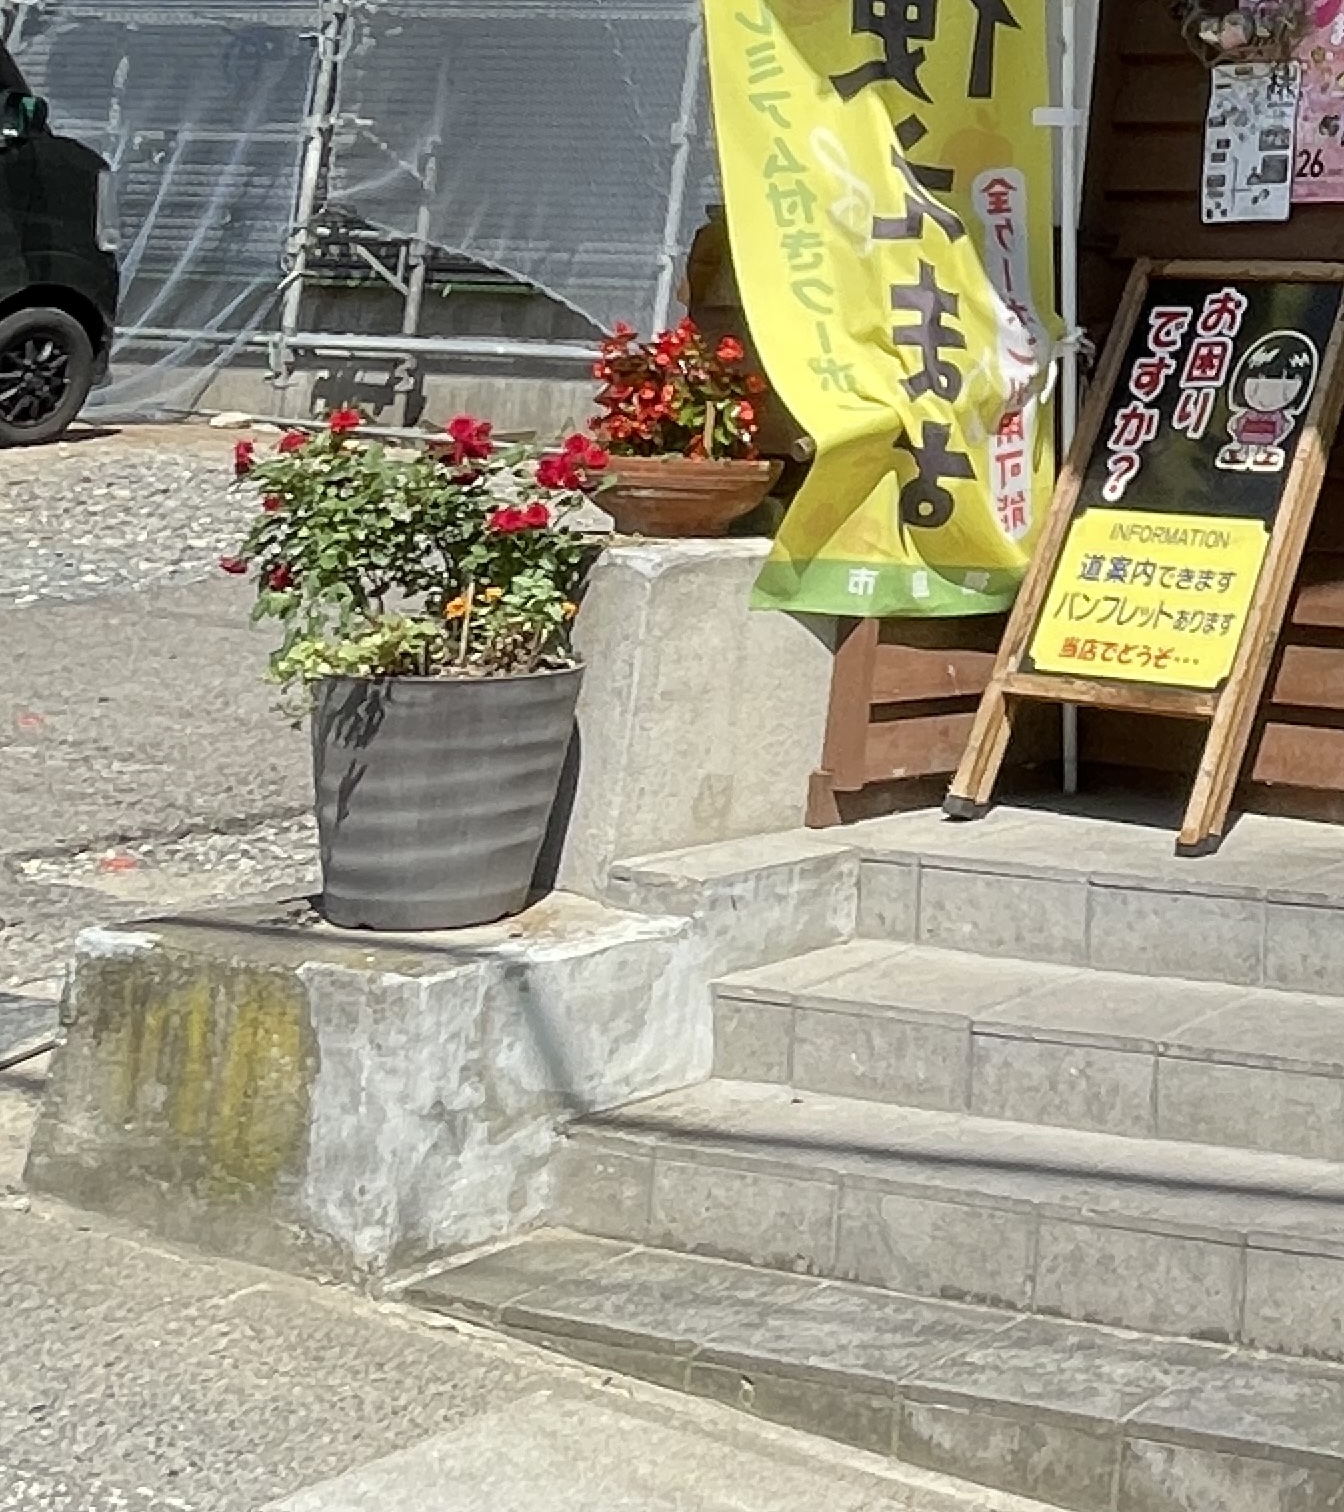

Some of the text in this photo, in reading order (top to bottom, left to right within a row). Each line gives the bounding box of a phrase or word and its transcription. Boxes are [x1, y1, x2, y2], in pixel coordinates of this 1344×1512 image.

[1173, 289, 1246, 437] お困り
[1109, 523, 1232, 549] INFORMATION
[1076, 553, 1237, 593] 道案内できます
[1053, 591, 1236, 636] パンフレットあります
